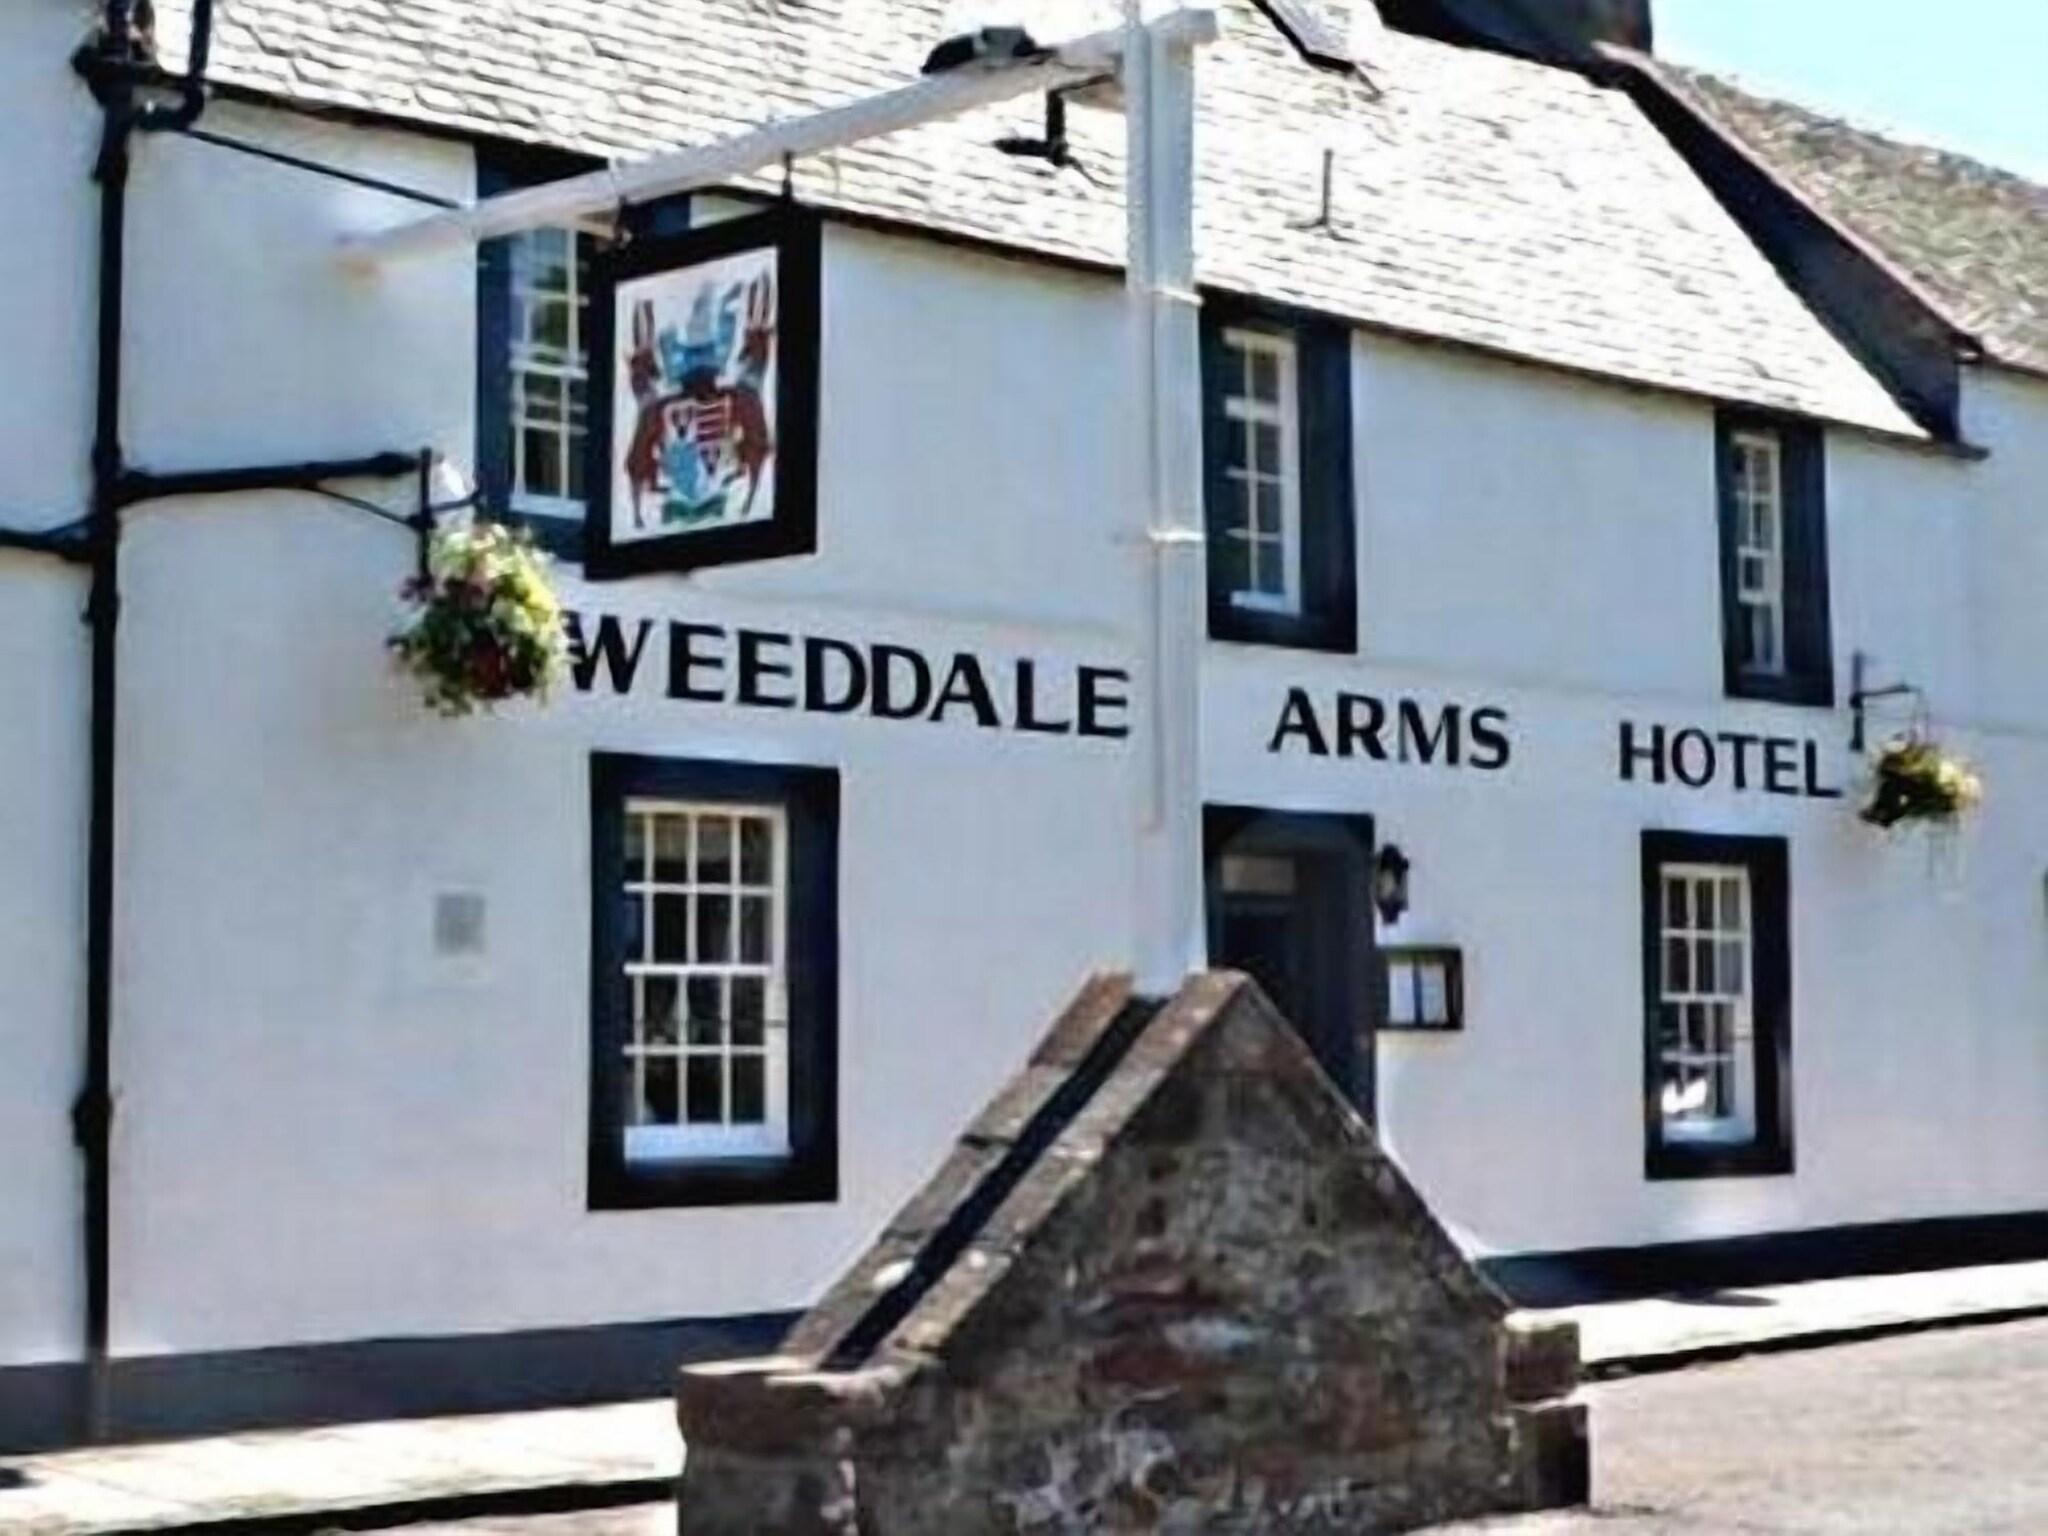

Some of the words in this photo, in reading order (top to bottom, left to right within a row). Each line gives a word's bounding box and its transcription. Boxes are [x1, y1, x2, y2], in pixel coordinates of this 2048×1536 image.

[562, 610, 1131, 738] WEEDDALE
[1268, 687, 1511, 771] ARMS
[1618, 720, 1843, 799] HOTEL
